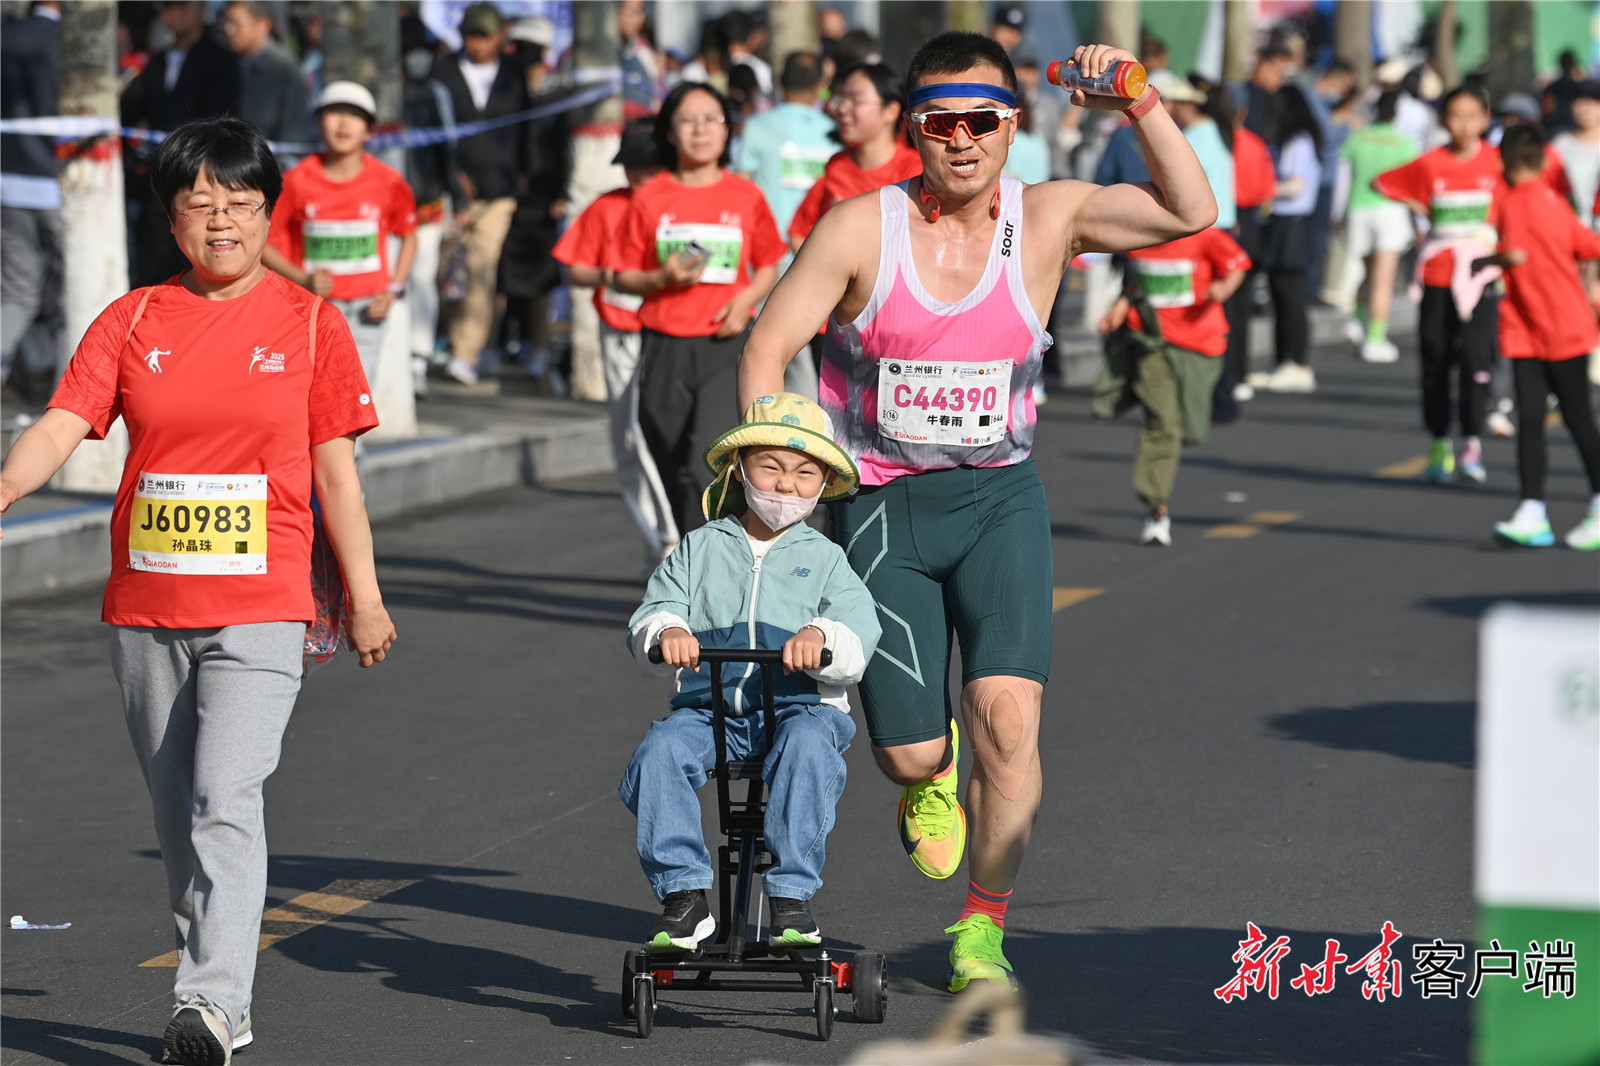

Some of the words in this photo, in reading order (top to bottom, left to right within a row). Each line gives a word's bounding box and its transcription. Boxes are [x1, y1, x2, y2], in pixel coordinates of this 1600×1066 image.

[1001, 220, 1014, 258] soar
[270, 352, 285, 361] 2025
[904, 364, 943, 375] 兰州银行
[894, 384, 997, 412] C44390
[889, 412, 896, 420] 16
[926, 415, 963, 427] 牛春雨
[899, 433, 928, 441] QIAODAN
[146, 479, 186, 491] 兰州银行
[140, 503, 251, 533] J60983
[172, 539, 213, 552] 孙晶珠
[146, 560, 178, 569] QIAODAN
